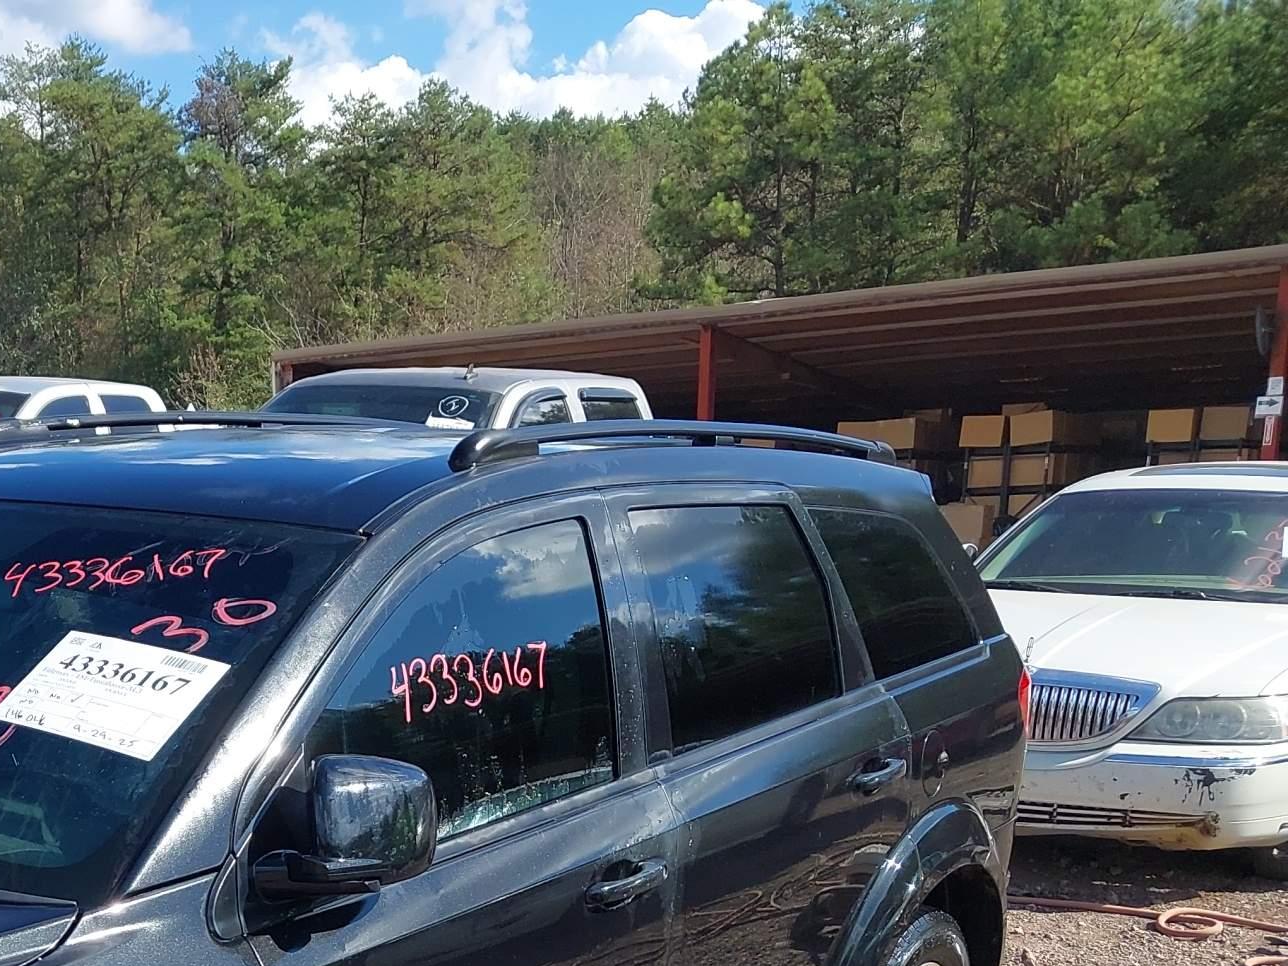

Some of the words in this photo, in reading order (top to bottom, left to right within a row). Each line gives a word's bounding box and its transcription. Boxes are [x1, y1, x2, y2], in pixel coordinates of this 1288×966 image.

[4, 548, 226, 598] 43336167
[59, 653, 191, 695] 43336167
[390, 640, 547, 724] 43336167
